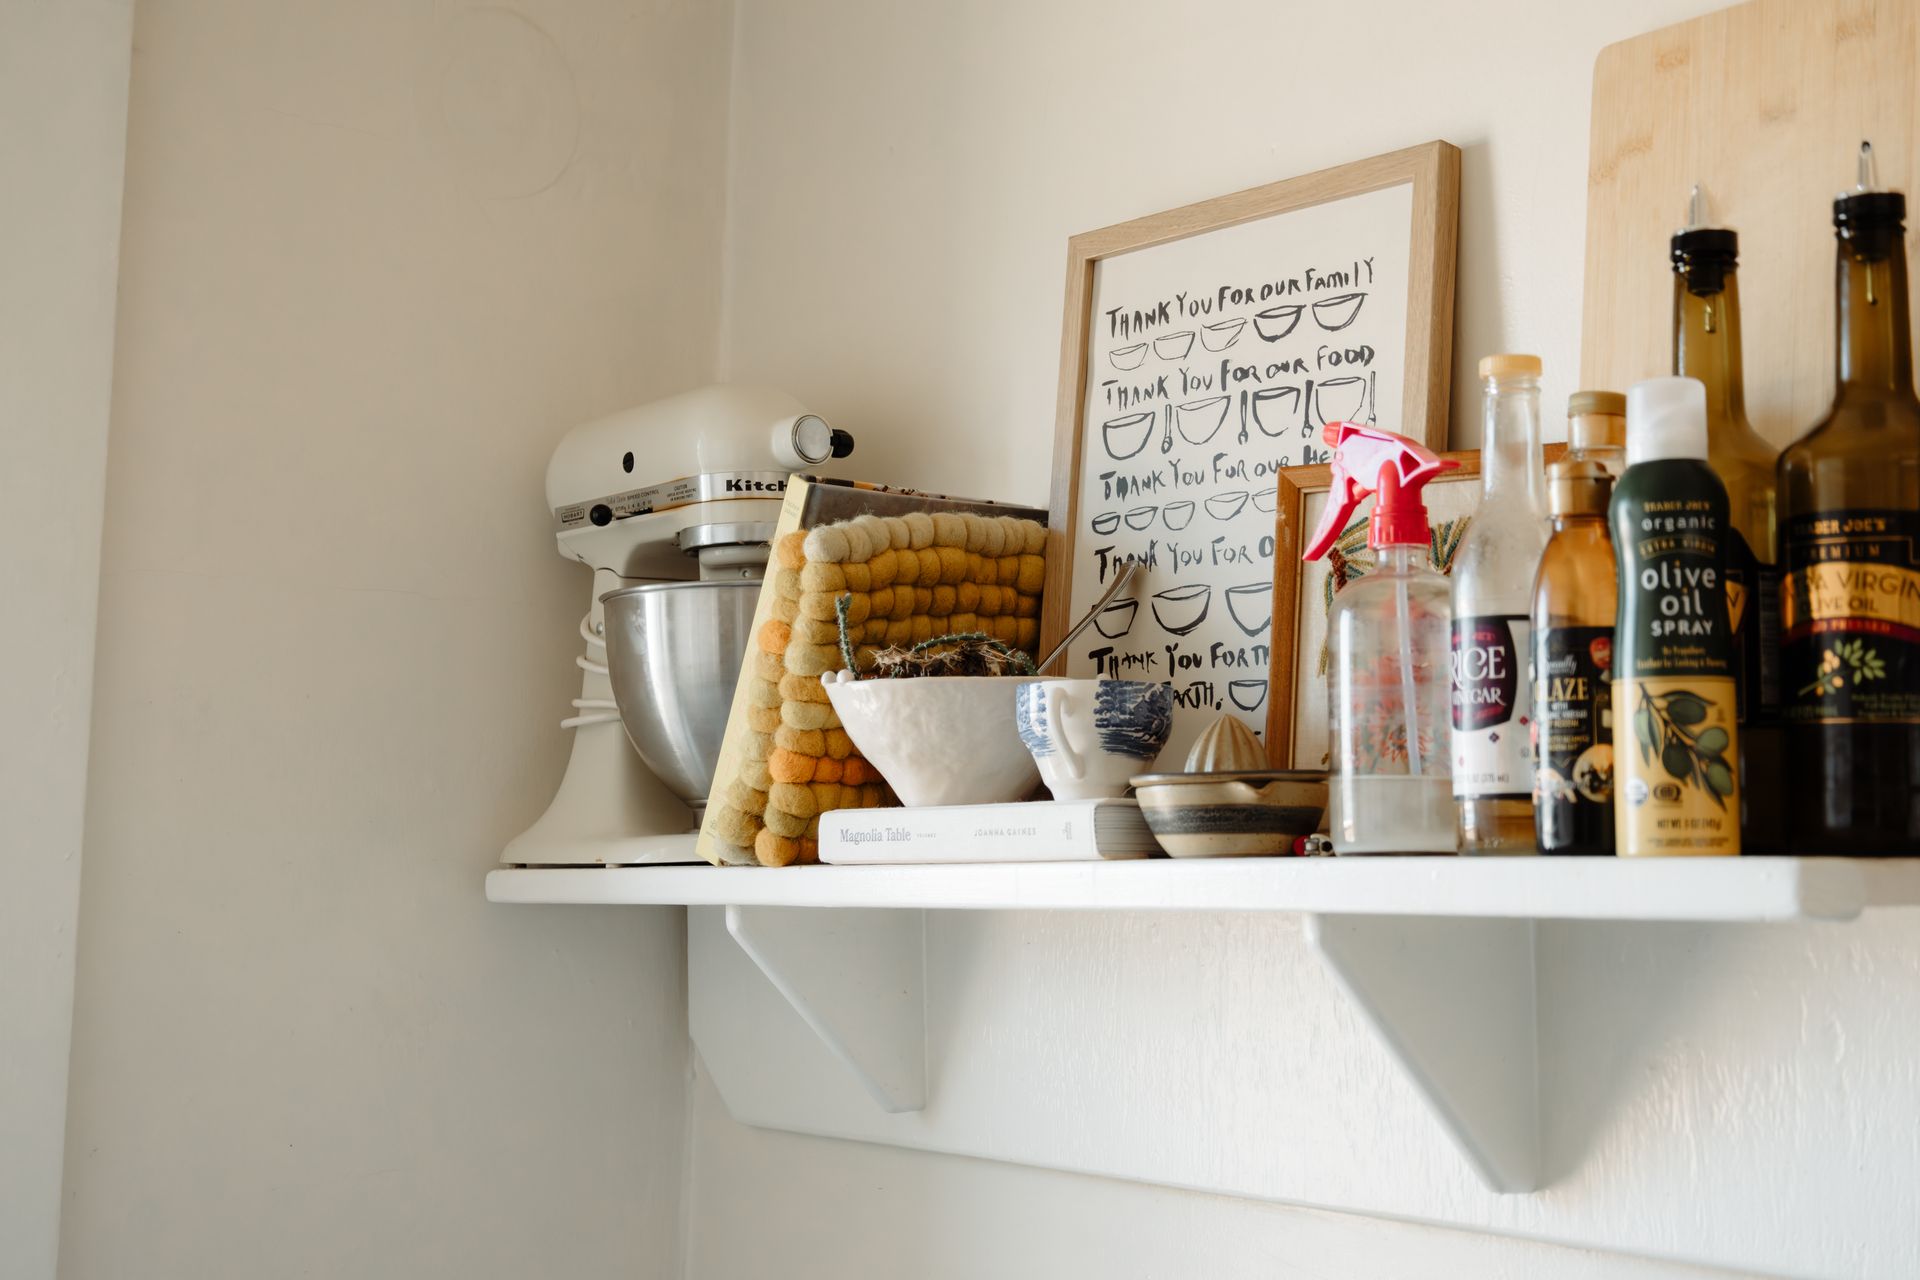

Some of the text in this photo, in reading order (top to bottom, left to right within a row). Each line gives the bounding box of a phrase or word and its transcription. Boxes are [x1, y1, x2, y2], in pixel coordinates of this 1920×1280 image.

[1106, 301, 1170, 341] THANK
[1176, 291, 1212, 318] YOU
[1218, 285, 1255, 312] FOR
[1260, 277, 1301, 301] OUR
[1102, 344, 1375, 411] THANK YOU FOR OUR FOOD
[1100, 470, 1166, 502] THANK
[1168, 458, 1205, 487] YOU
[1303, 445, 1333, 466] HE
[1641, 515, 1715, 532] organic
[1166, 543, 1203, 574] YOU
[1211, 536, 1253, 566] FOR
[1641, 560, 1716, 590] olive
[1660, 588, 1703, 616] oil
[1849, 596, 1879, 612] OIL
[1651, 620, 1713, 636] SPRAY
[1088, 646, 1158, 680] THANK
[1165, 643, 1203, 677] YOU
[1162, 680, 1223, 711] ARTH.
[840, 828, 883, 845] Magnolia
[885, 828, 911, 842] Table
